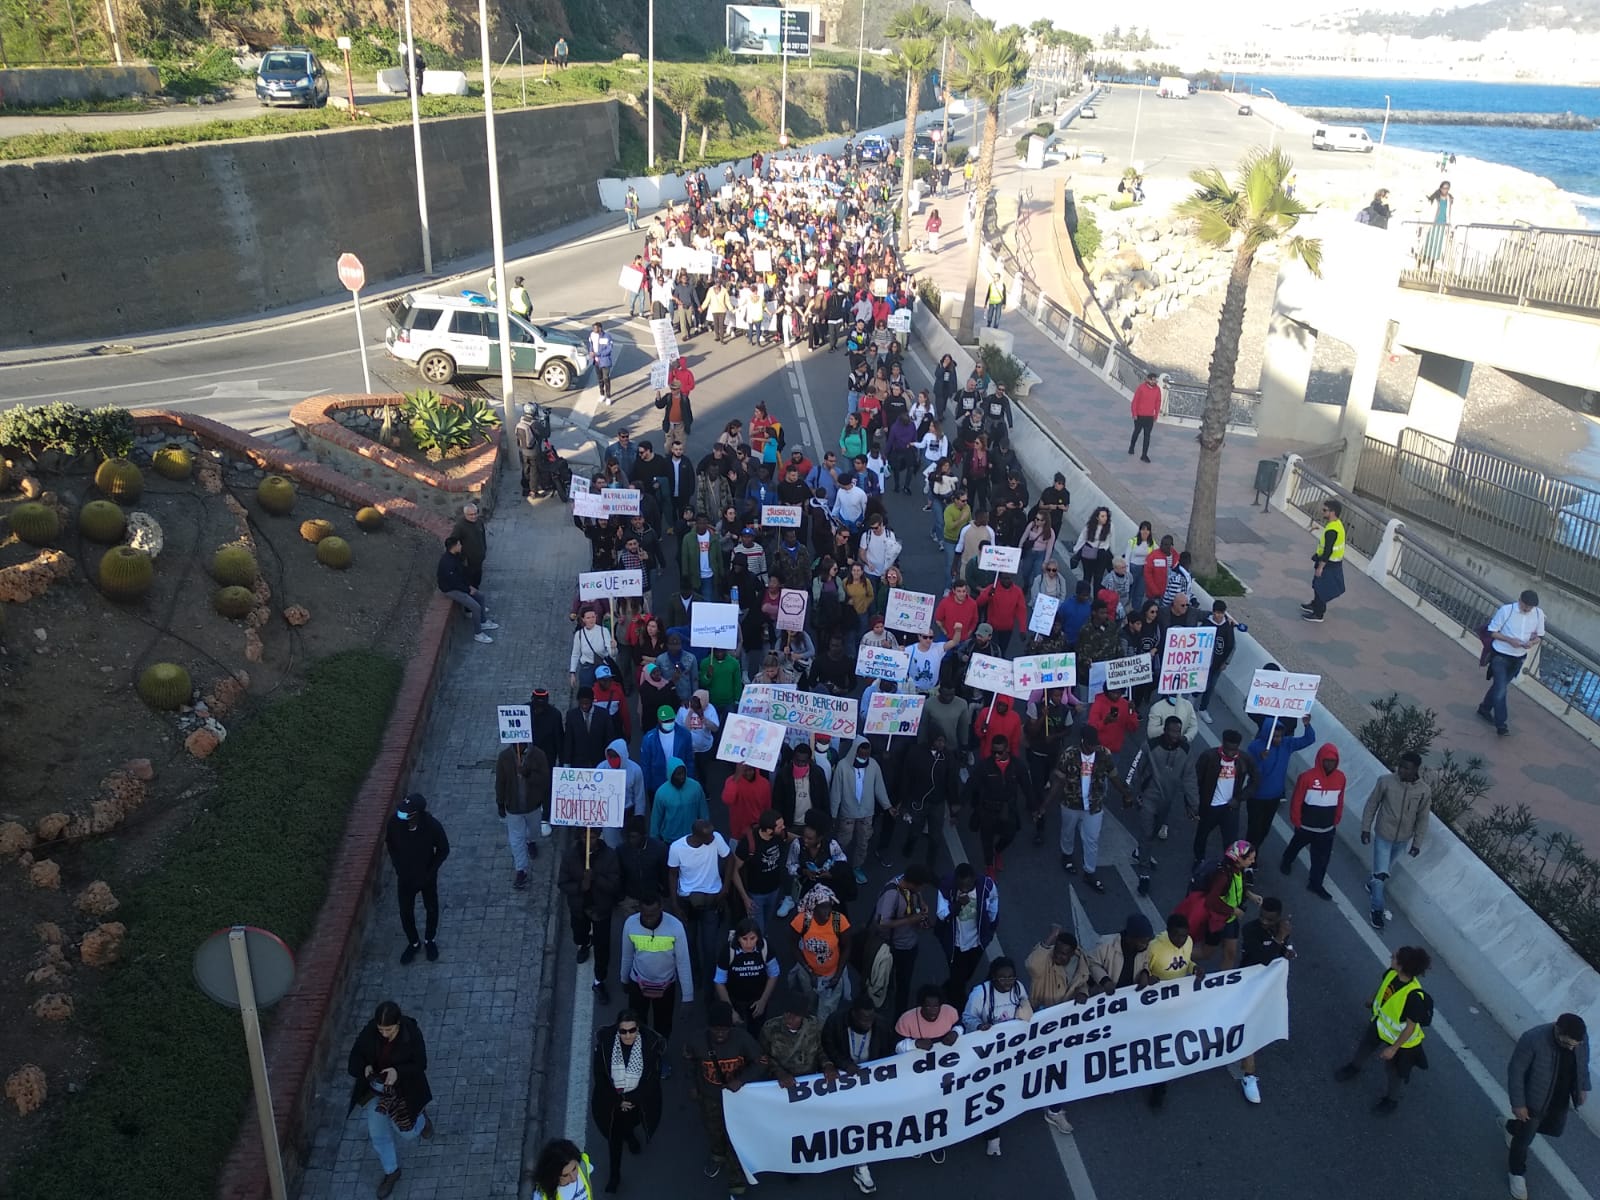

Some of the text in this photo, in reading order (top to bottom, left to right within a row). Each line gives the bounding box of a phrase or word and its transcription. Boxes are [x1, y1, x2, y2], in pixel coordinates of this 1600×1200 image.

[1169, 632, 1214, 648] BASTA
[1167, 650, 1203, 665] MORTI
[865, 666, 896, 678] JUSTICIA
[1162, 671, 1198, 690] MARE
[772, 689, 809, 706] TENEMOS
[812, 695, 849, 712] DERECHO
[508, 719, 521, 728] NO
[733, 719, 778, 746] STOP
[560, 771, 604, 782] ABAJO
[577, 784, 597, 792] LAS
[555, 797, 608, 822] FRONTERAS
[787, 970, 1244, 1104] Basta de violencia en las
[939, 1024, 1112, 1097] fronteras:
[790, 1023, 1246, 1165] MIGRAR ES UN DERECHO
